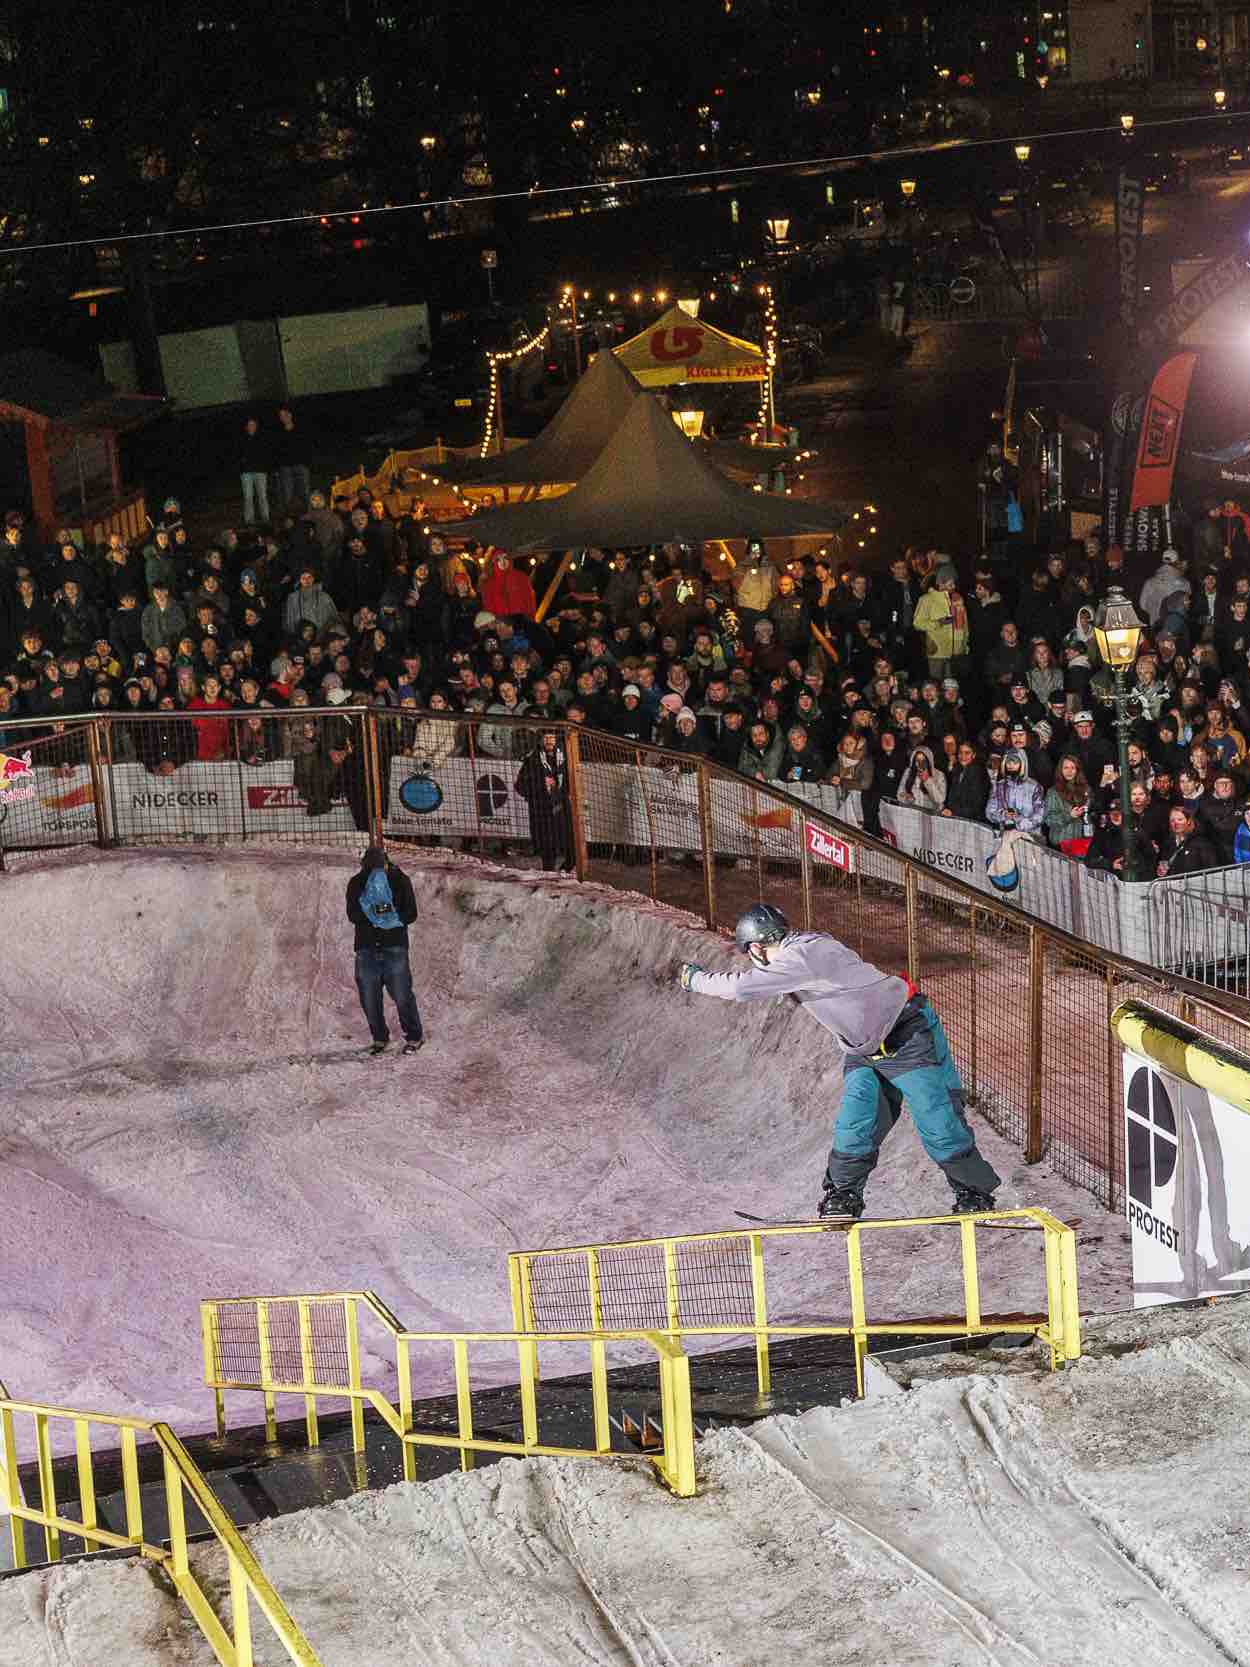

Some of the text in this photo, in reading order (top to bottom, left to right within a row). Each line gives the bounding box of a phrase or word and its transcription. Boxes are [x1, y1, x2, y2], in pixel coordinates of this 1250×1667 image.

[131, 792, 219, 809] NIDECKER
[43, 819, 97, 832] TOPSPOR
[811, 829, 845, 865] Zillertal
[913, 847, 975, 873] NIDECKER
[1129, 1202, 1180, 1252] PROTEST
